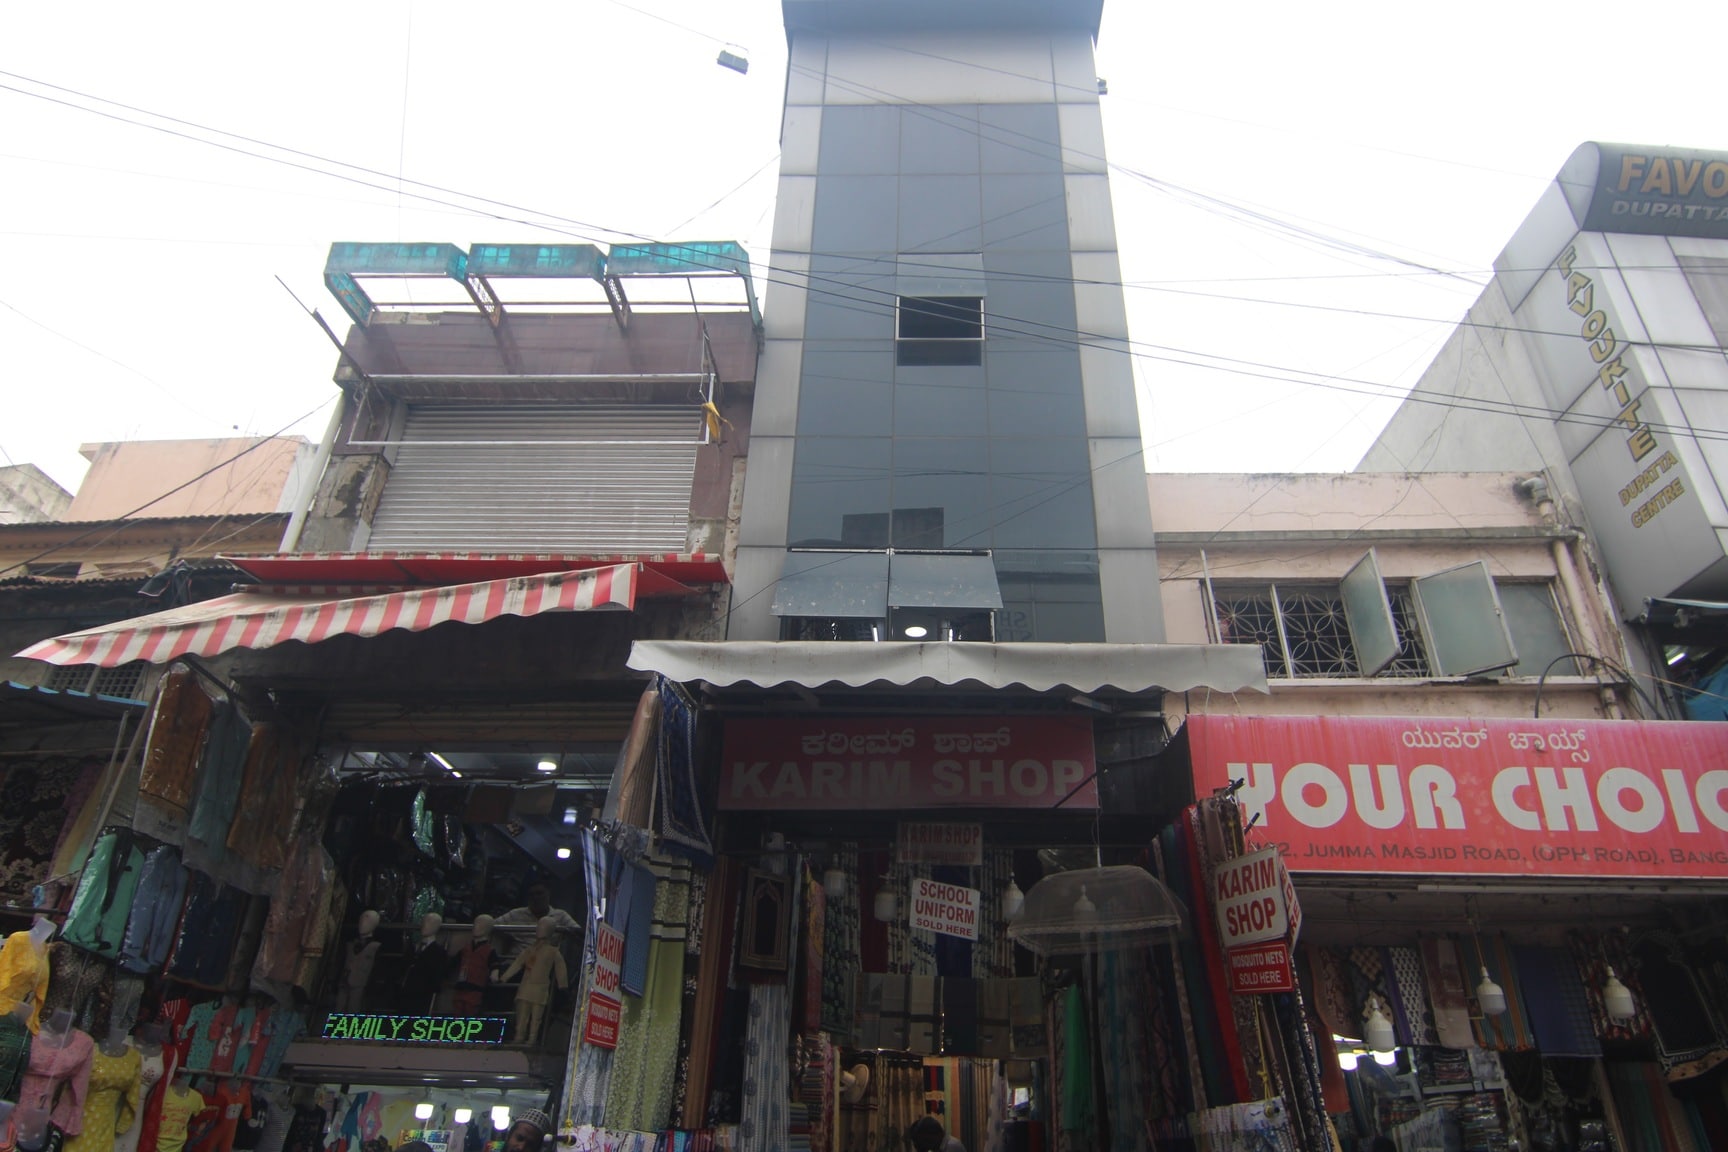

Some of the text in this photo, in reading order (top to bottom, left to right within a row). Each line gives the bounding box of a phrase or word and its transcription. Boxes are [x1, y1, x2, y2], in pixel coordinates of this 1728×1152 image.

[1617, 155, 1728, 198] FAVO
[1611, 200, 1728, 221] DUPATTA
[1556, 245, 1657, 462] FAVOURITE
[1618, 450, 1678, 507] DUPATTA
[1631, 477, 1685, 528] CENTRE
[730, 759, 1085, 798] KARIM SHOP
[1226, 763, 1466, 829] YOUR
[945, 824, 980, 845] SHOP
[1218, 857, 1277, 900] KARIM
[920, 881, 972, 906] SCHOOL
[915, 900, 974, 925] UNIFORM
[1226, 897, 1276, 937] SHOP
[916, 918, 972, 936] SOLD HERE
[1232, 950, 1285, 968] MOSQUITO NETS
[595, 965, 619, 993] SHOP
[1239, 970, 1282, 985] SOLD HERE
[323, 1015, 483, 1041] FAMILY SHOP
[591, 1022, 602, 1036] SOLD
